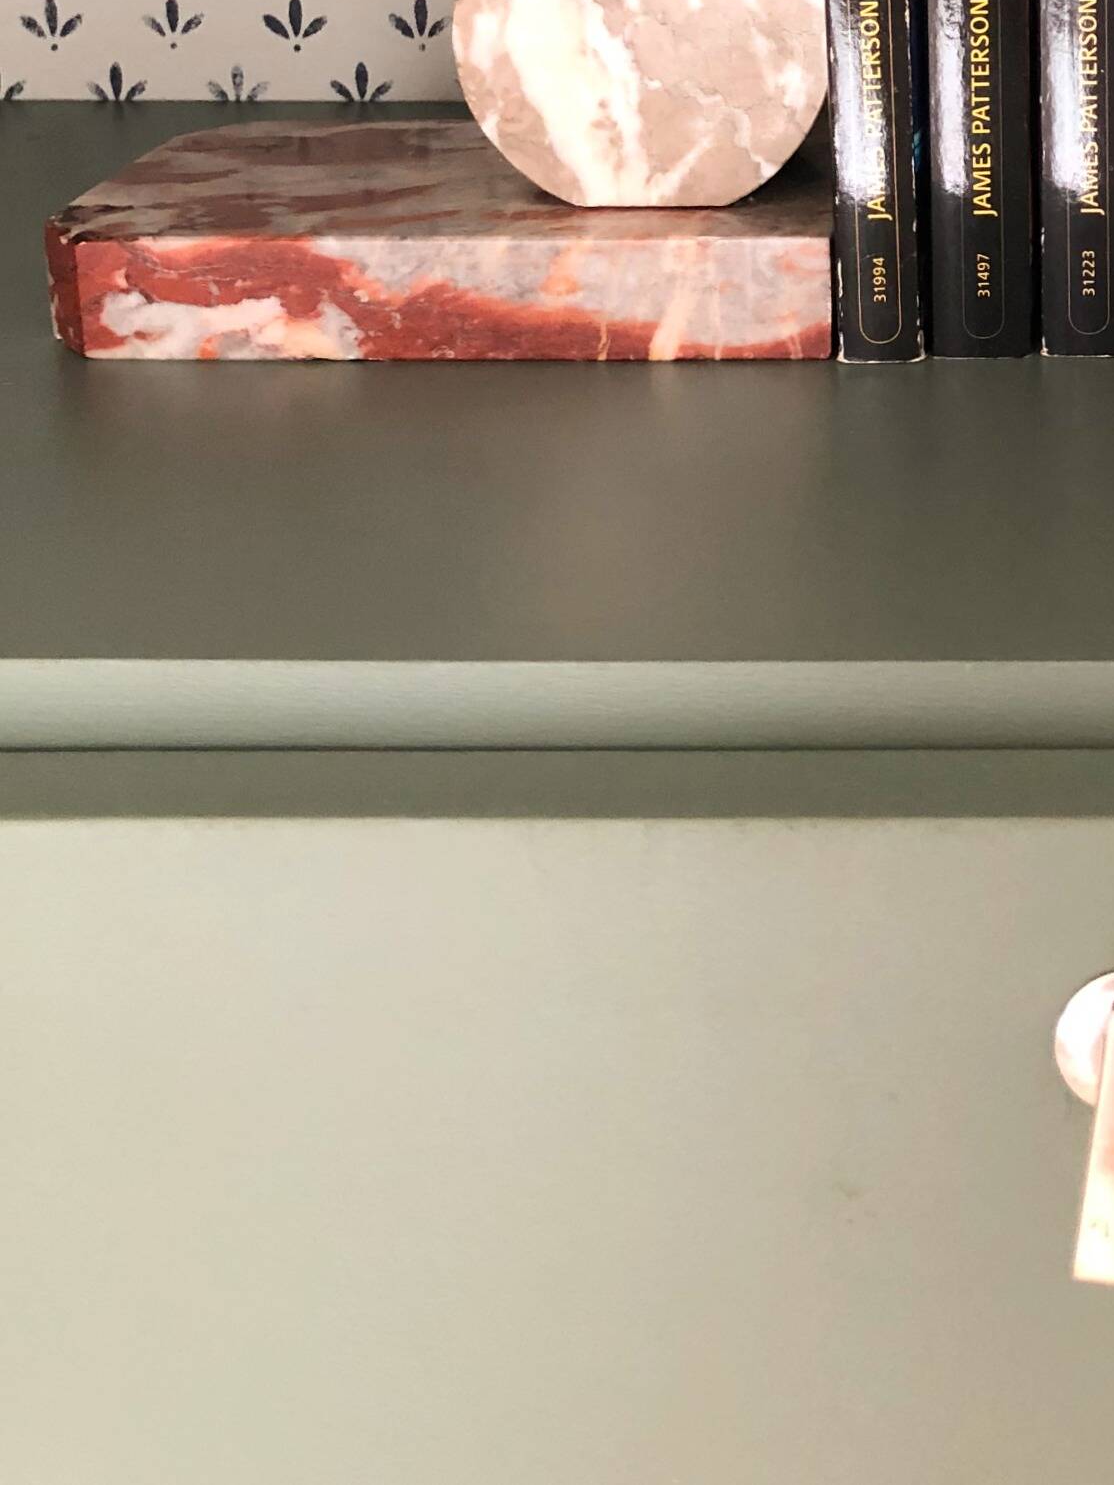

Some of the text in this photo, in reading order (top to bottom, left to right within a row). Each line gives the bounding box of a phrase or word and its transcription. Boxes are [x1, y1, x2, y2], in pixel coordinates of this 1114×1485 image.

[859, 0, 893, 221] JAMES PATTERSON
[972, 142, 998, 217] JAMES
[1080, 141, 1105, 216] JAMES
[873, 257, 887, 303] 31994
[977, 253, 991, 298] 31497
[1082, 250, 1096, 296] 31223
